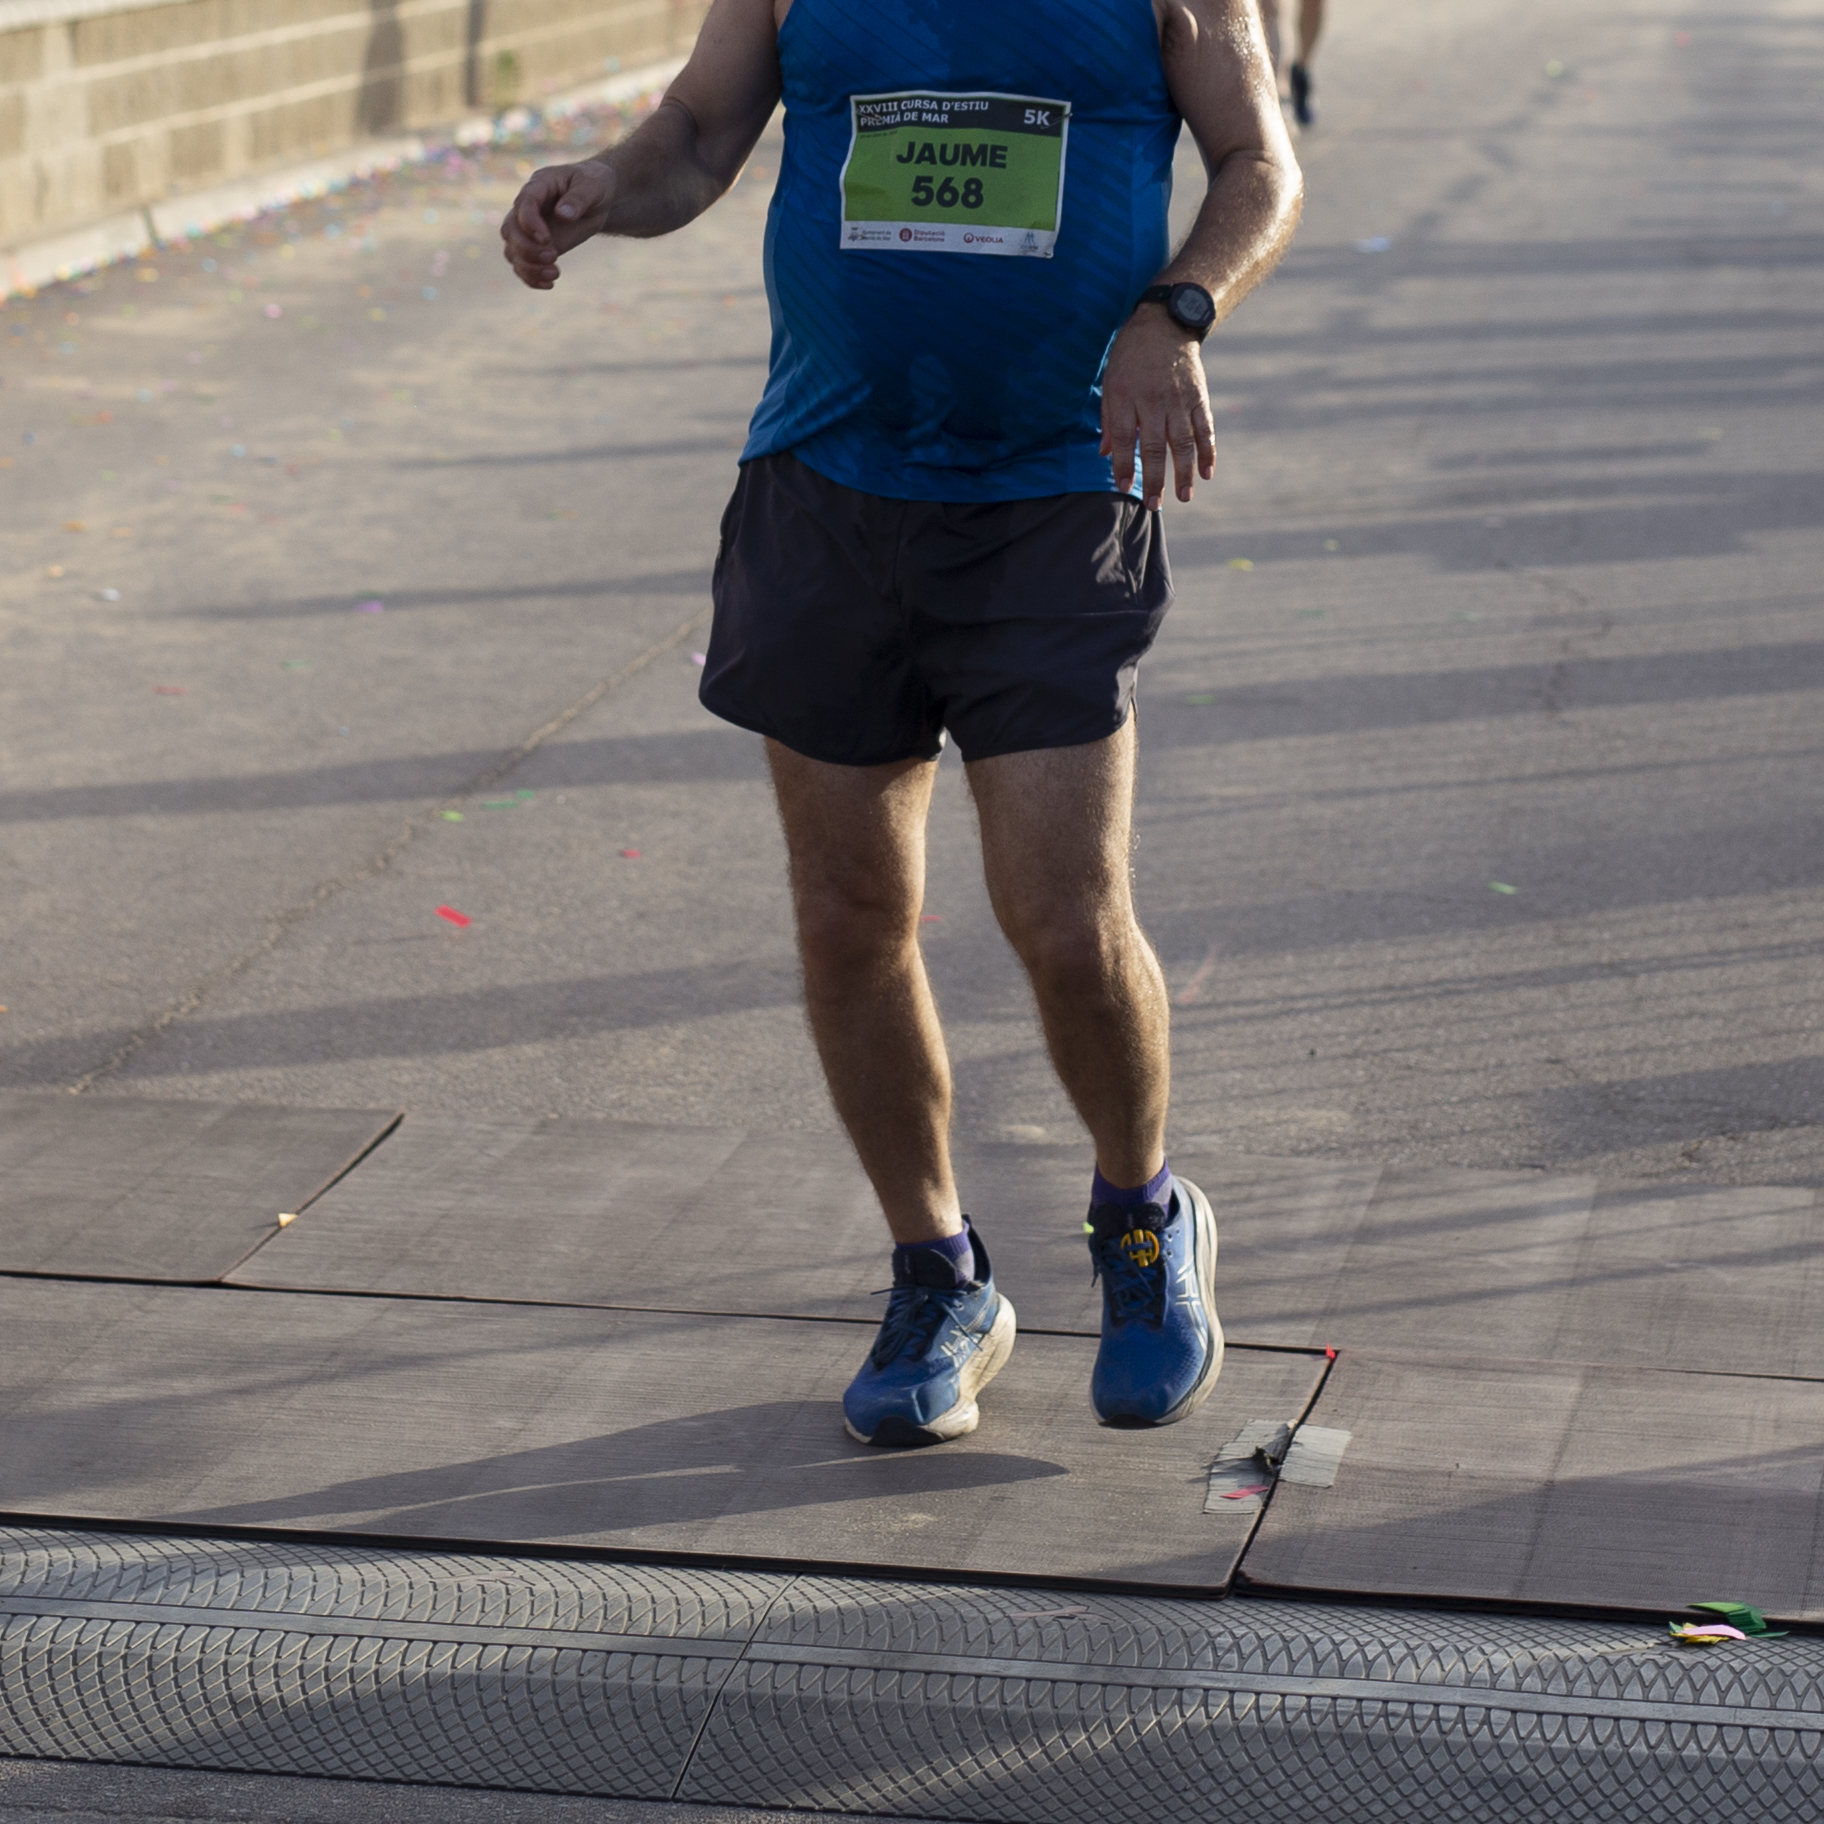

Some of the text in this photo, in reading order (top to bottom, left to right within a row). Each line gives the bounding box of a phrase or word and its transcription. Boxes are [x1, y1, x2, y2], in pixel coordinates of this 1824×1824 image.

[858, 99, 989, 114] XXVIII CURSA D'ESTIU
[860, 111, 949, 127] PREMIÀ DE MAR
[1023, 109, 1051, 127] 5K
[896, 140, 1009, 169] JAUME
[910, 175, 985, 209] 568
[975, 236, 1004, 244] VEOLIA
